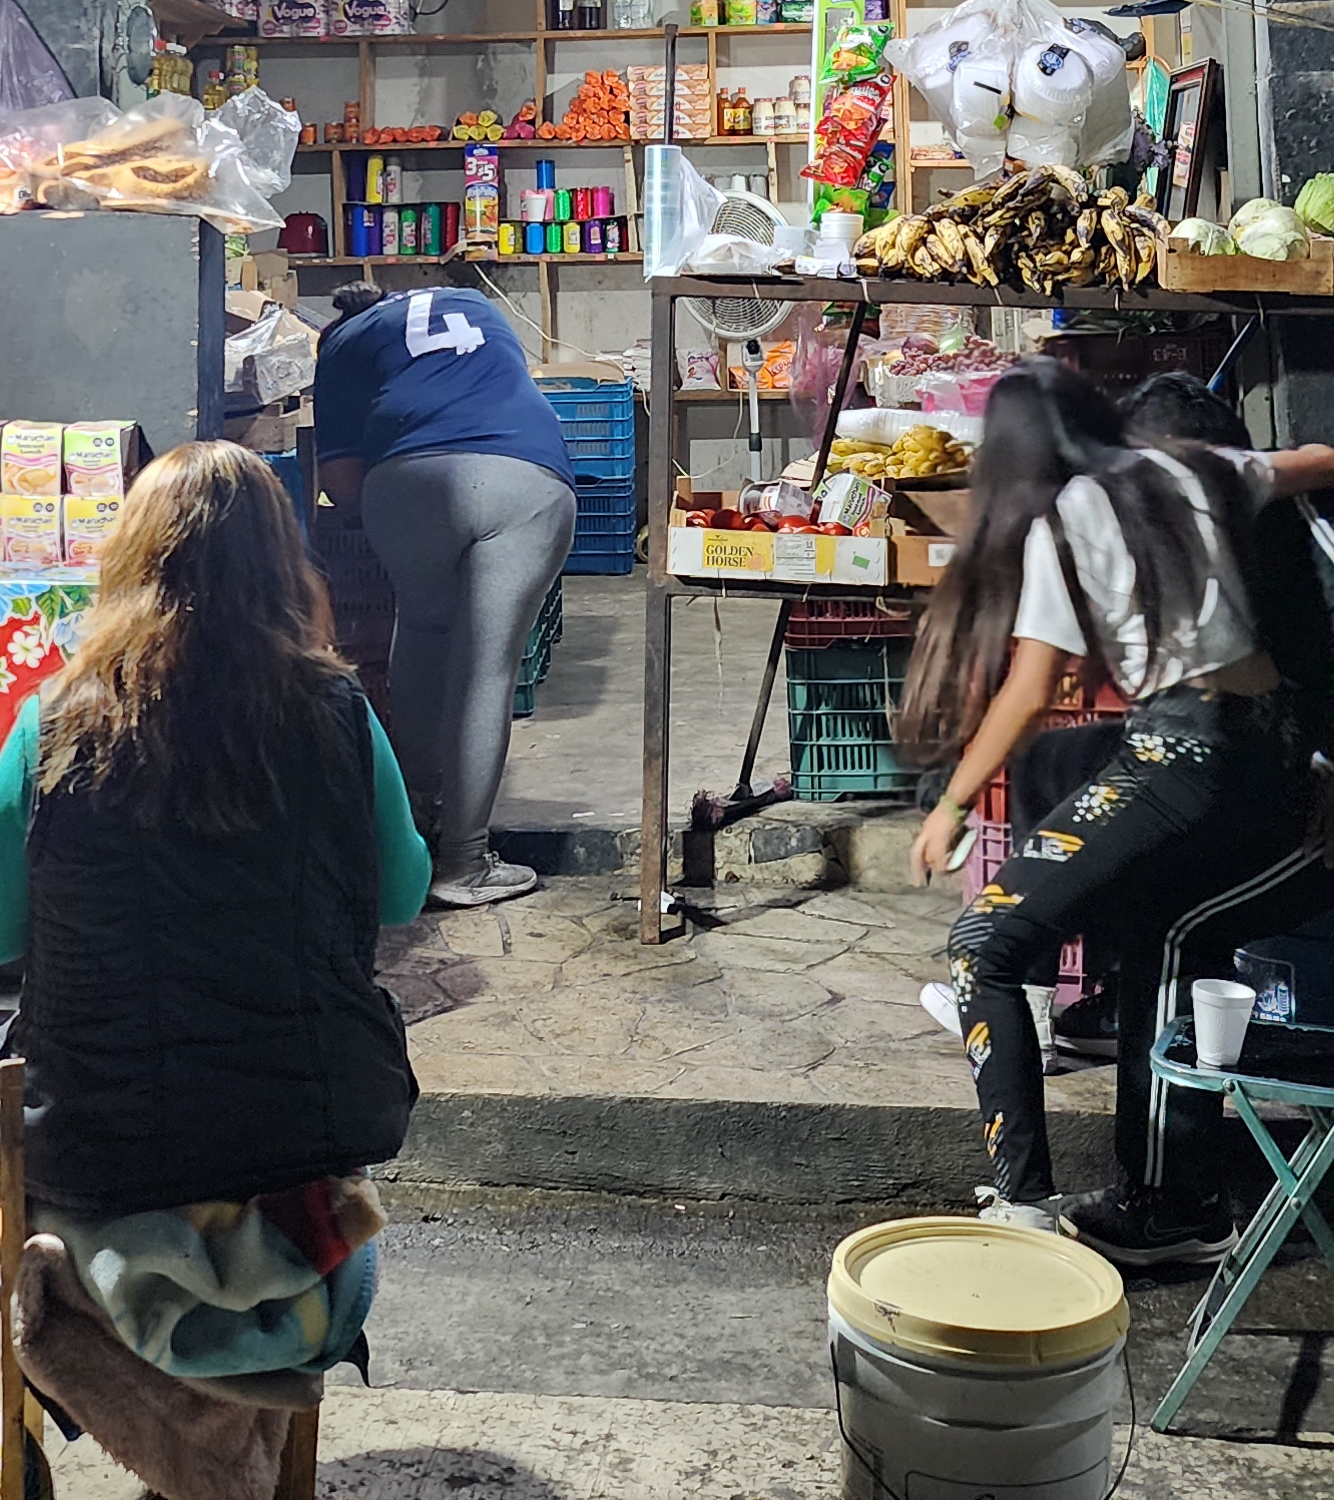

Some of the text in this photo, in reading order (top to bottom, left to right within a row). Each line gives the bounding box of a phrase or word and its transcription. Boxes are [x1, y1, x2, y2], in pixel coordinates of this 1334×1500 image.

[273, 3, 315, 20] Vogue
[344, 0, 387, 19] Vogue
[406, 292, 486, 358] 4
[843, 482, 861, 514] Maruchan
[705, 544, 755, 557] GOLDEN
[705, 555, 747, 567] HORSE
